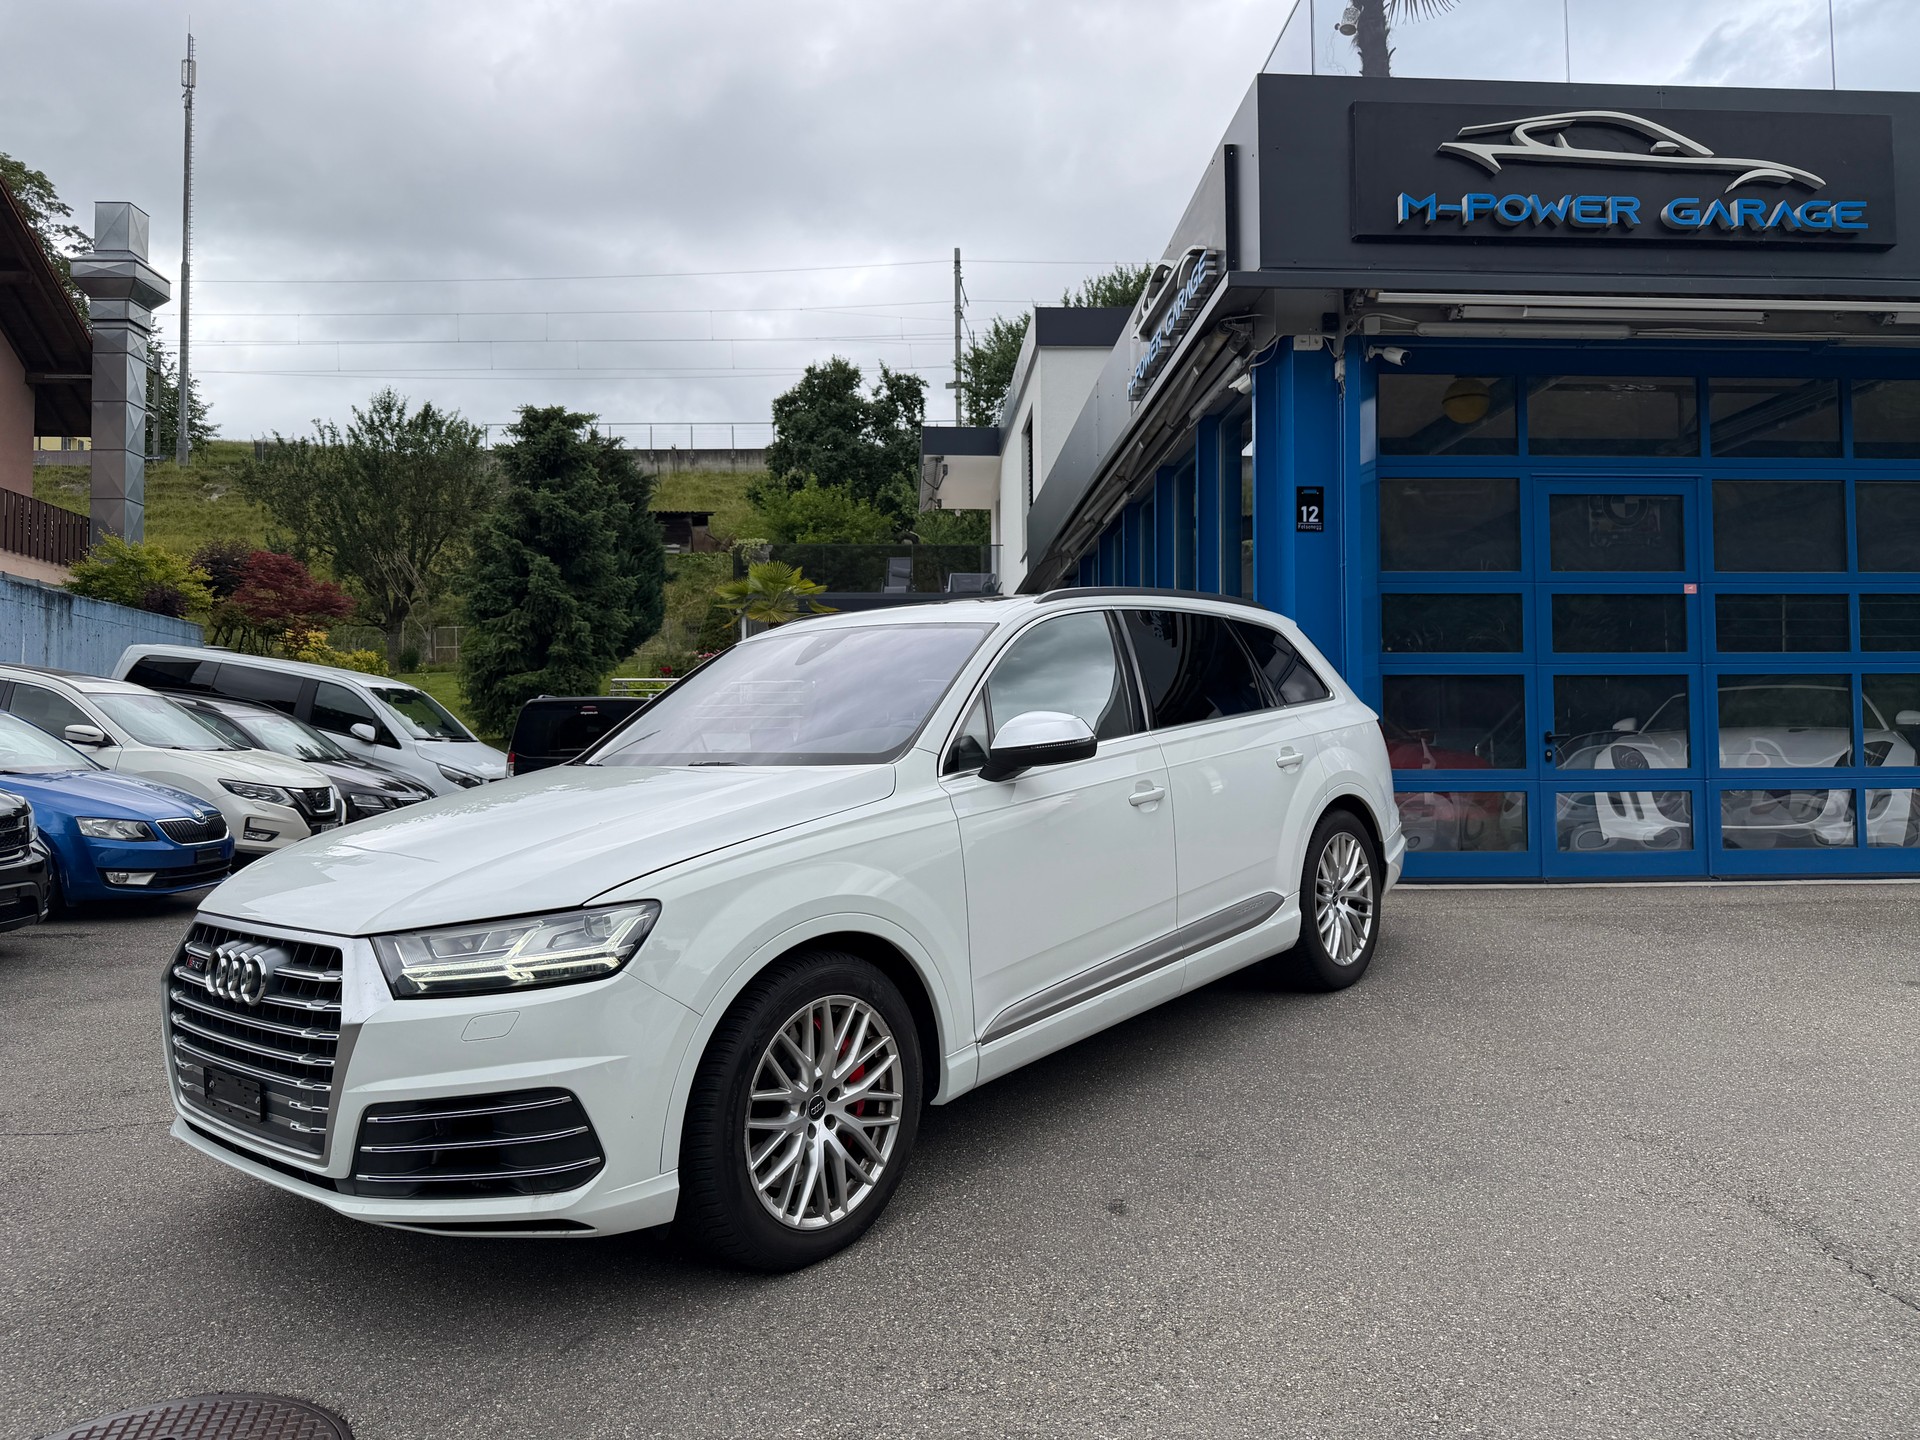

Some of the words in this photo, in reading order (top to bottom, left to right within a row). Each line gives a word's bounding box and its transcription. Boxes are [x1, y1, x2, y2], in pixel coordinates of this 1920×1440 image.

[1399, 192, 1641, 226] M-POWER
[1662, 197, 1869, 230] GARAGE
[1165, 249, 1208, 336] GARAGE
[1300, 505, 1319, 522] 12
